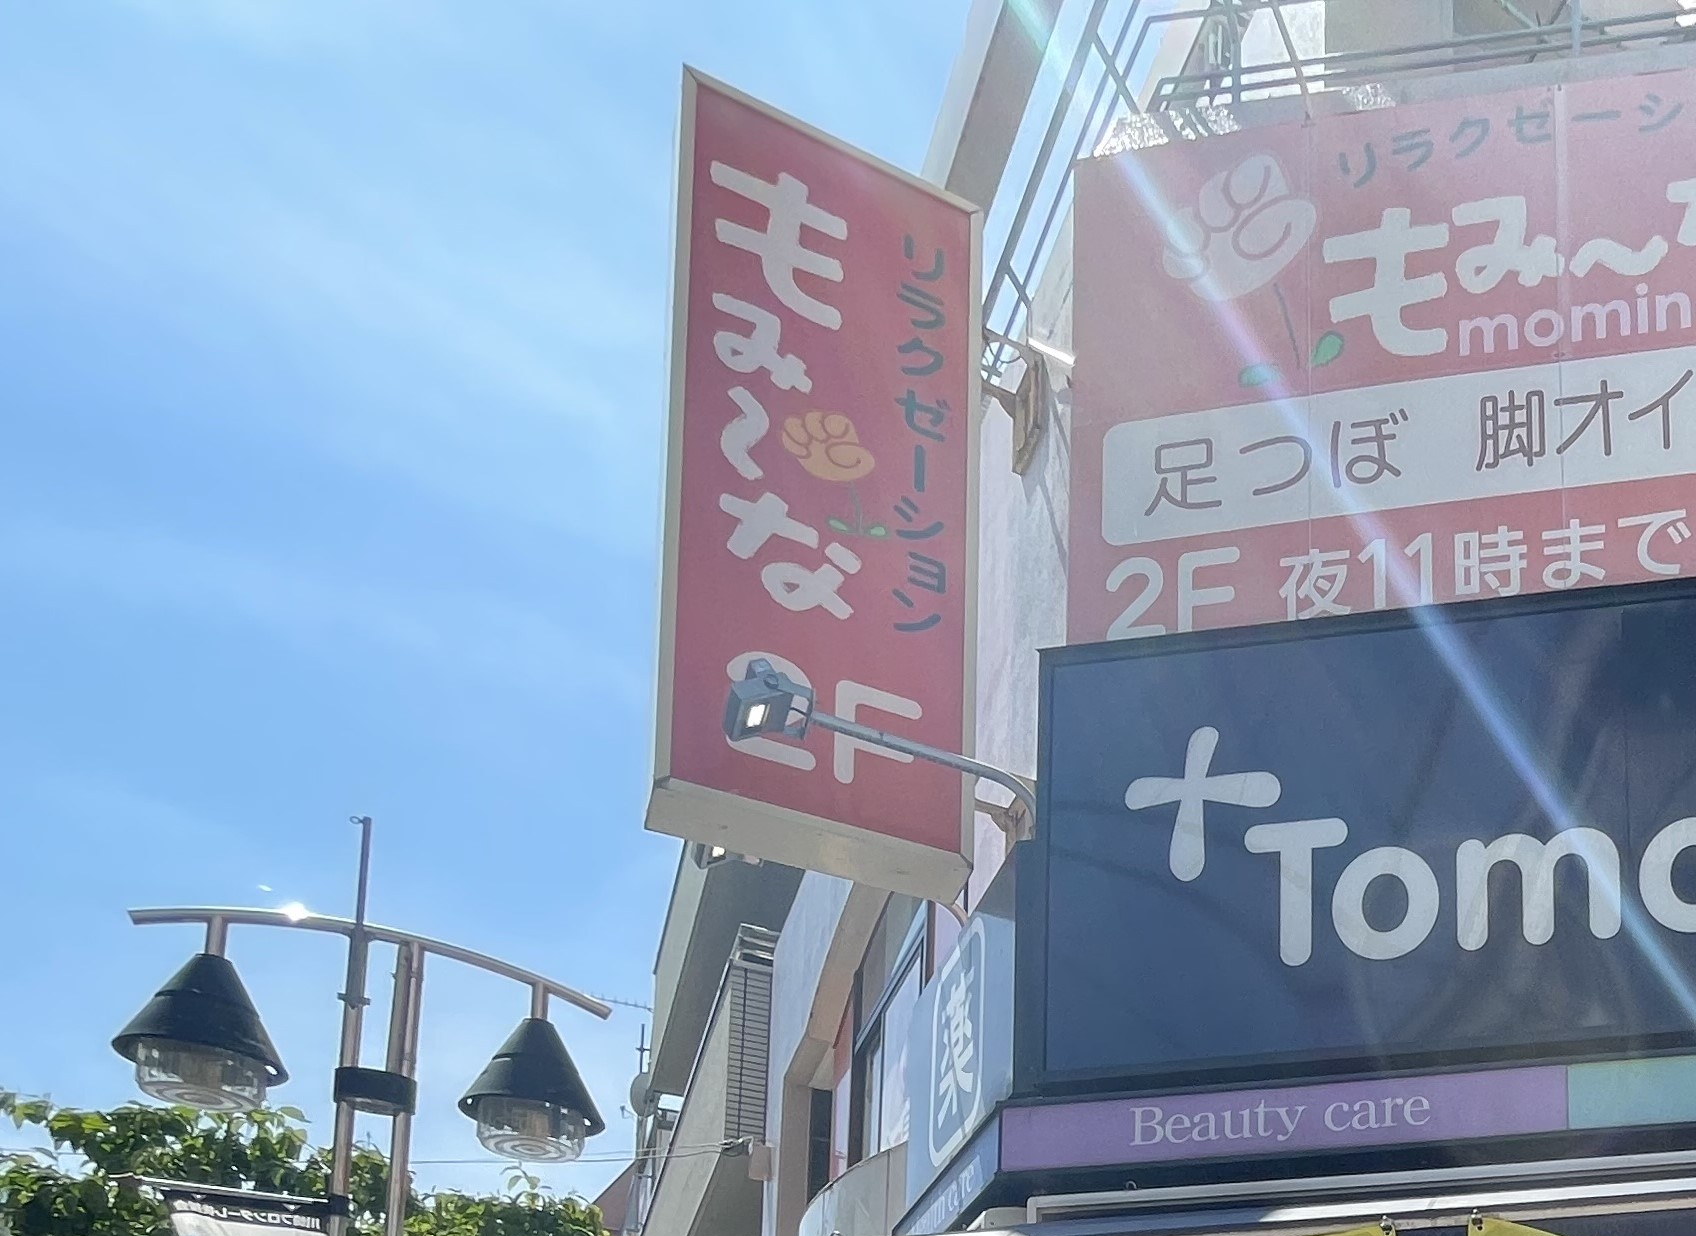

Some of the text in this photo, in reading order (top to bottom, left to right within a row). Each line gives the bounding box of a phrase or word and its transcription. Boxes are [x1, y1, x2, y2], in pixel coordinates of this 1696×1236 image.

[892, 233, 949, 634] リラクゼーション
[1146, 409, 1409, 517] 足つぼ
[1105, 508, 1692, 640] 2F 夜11時まで
[937, 966, 976, 1130] 薬
[1130, 1090, 1432, 1150] Beauty care
